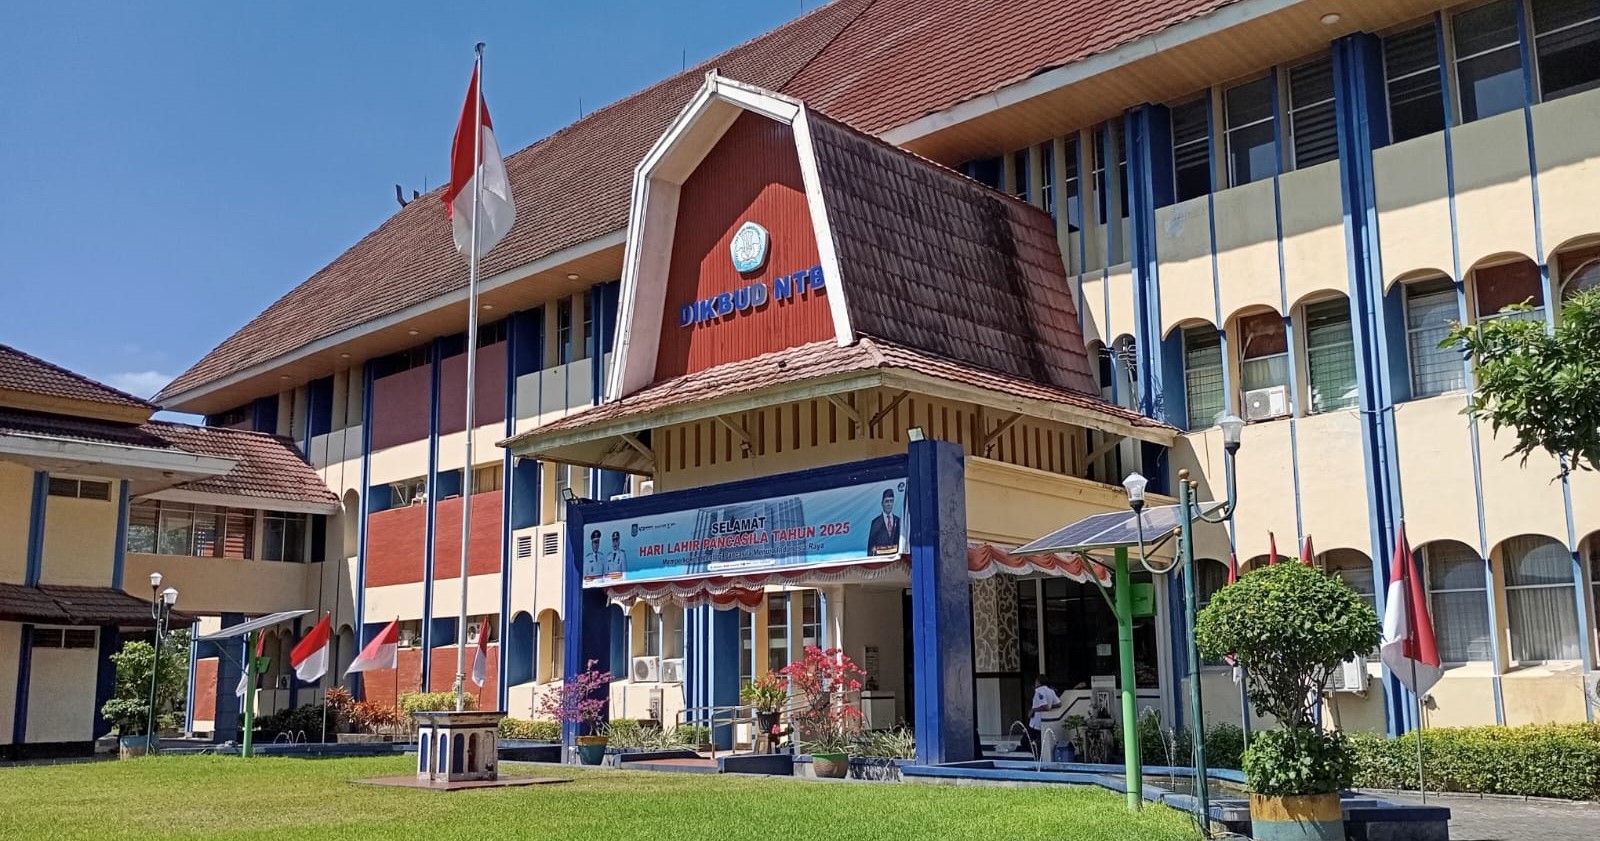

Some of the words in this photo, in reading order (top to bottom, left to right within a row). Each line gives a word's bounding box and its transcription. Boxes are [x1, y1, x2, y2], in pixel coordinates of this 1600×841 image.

[679, 283, 768, 327] DIKBUD
[774, 265, 826, 301] NTB
[639, 543, 664, 557] HARI
[667, 539, 700, 554] LAHIR
[703, 532, 768, 550] PANCASILA
[773, 526, 816, 542] TAHUN
[820, 521, 850, 537] 2025
[711, 516, 766, 534] SELAMAT
[662, 554, 699, 565] Memperko
[808, 542, 825, 552] Raya
